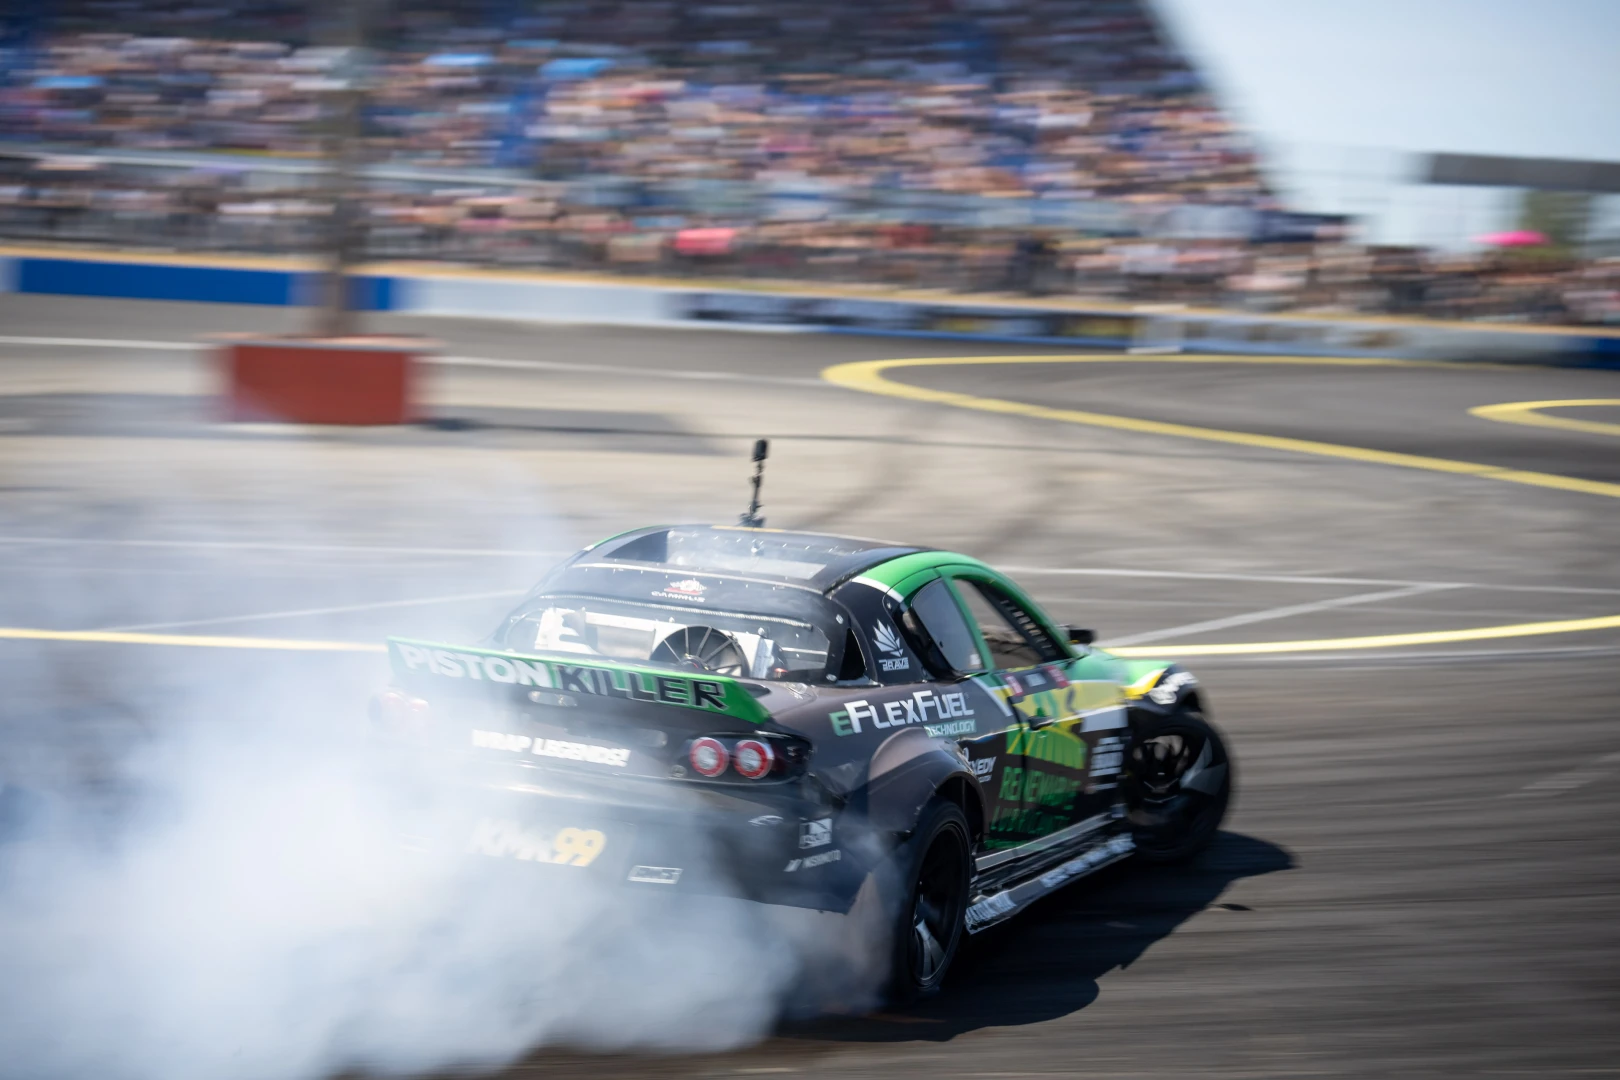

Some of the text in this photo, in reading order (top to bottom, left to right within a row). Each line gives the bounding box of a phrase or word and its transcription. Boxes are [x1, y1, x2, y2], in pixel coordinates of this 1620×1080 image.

[395, 642, 729, 711] PISTON KILLER
[923, 719, 977, 738] TECHNOLOGY
[969, 756, 997, 775] XEDY
